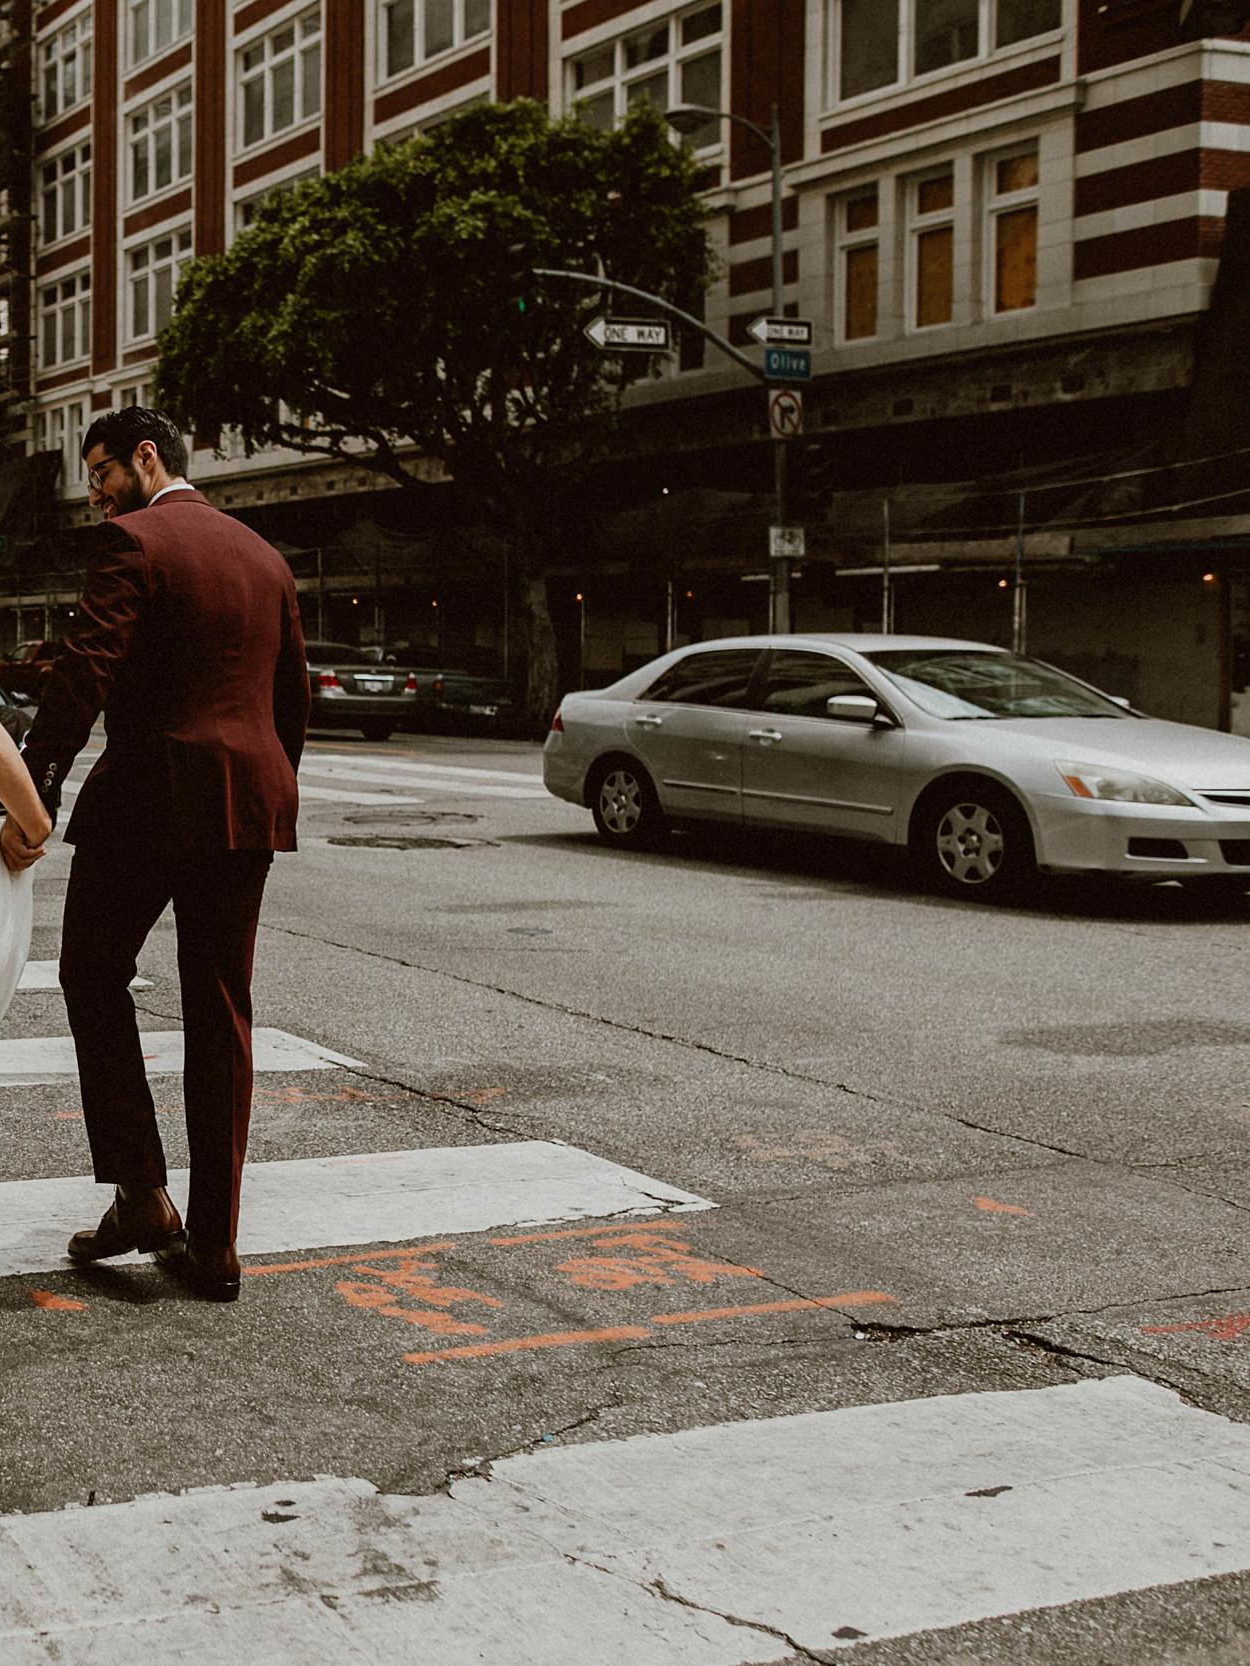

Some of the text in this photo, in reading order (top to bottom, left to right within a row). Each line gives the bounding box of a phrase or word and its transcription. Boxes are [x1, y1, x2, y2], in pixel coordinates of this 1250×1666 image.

[604, 327, 661, 342] ONE WAY
[767, 327, 805, 338] ONE WAY
[770, 353, 806, 371] Olive
